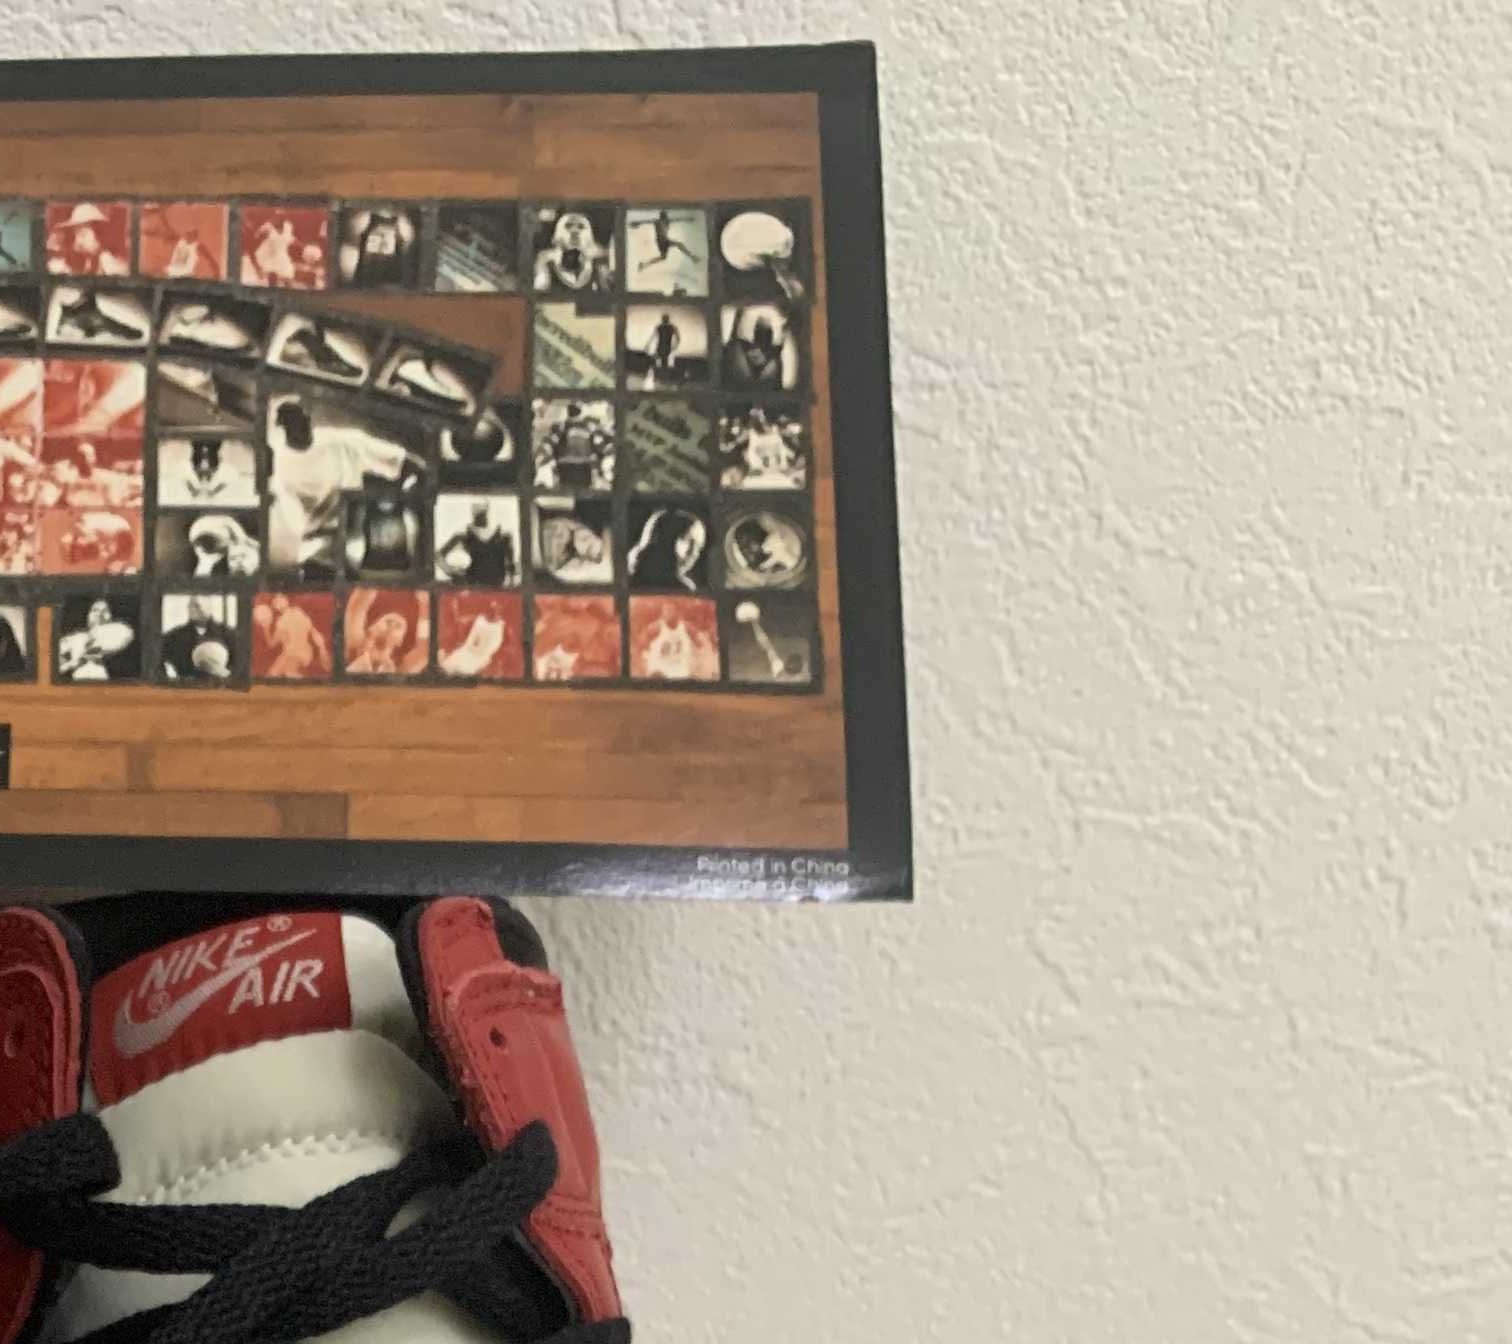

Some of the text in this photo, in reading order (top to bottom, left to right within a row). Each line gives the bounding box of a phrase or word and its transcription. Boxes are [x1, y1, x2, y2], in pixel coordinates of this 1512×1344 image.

[696, 855, 849, 875] Printed in China
[138, 926, 261, 999] NIKE
[228, 958, 325, 1015] AIR
